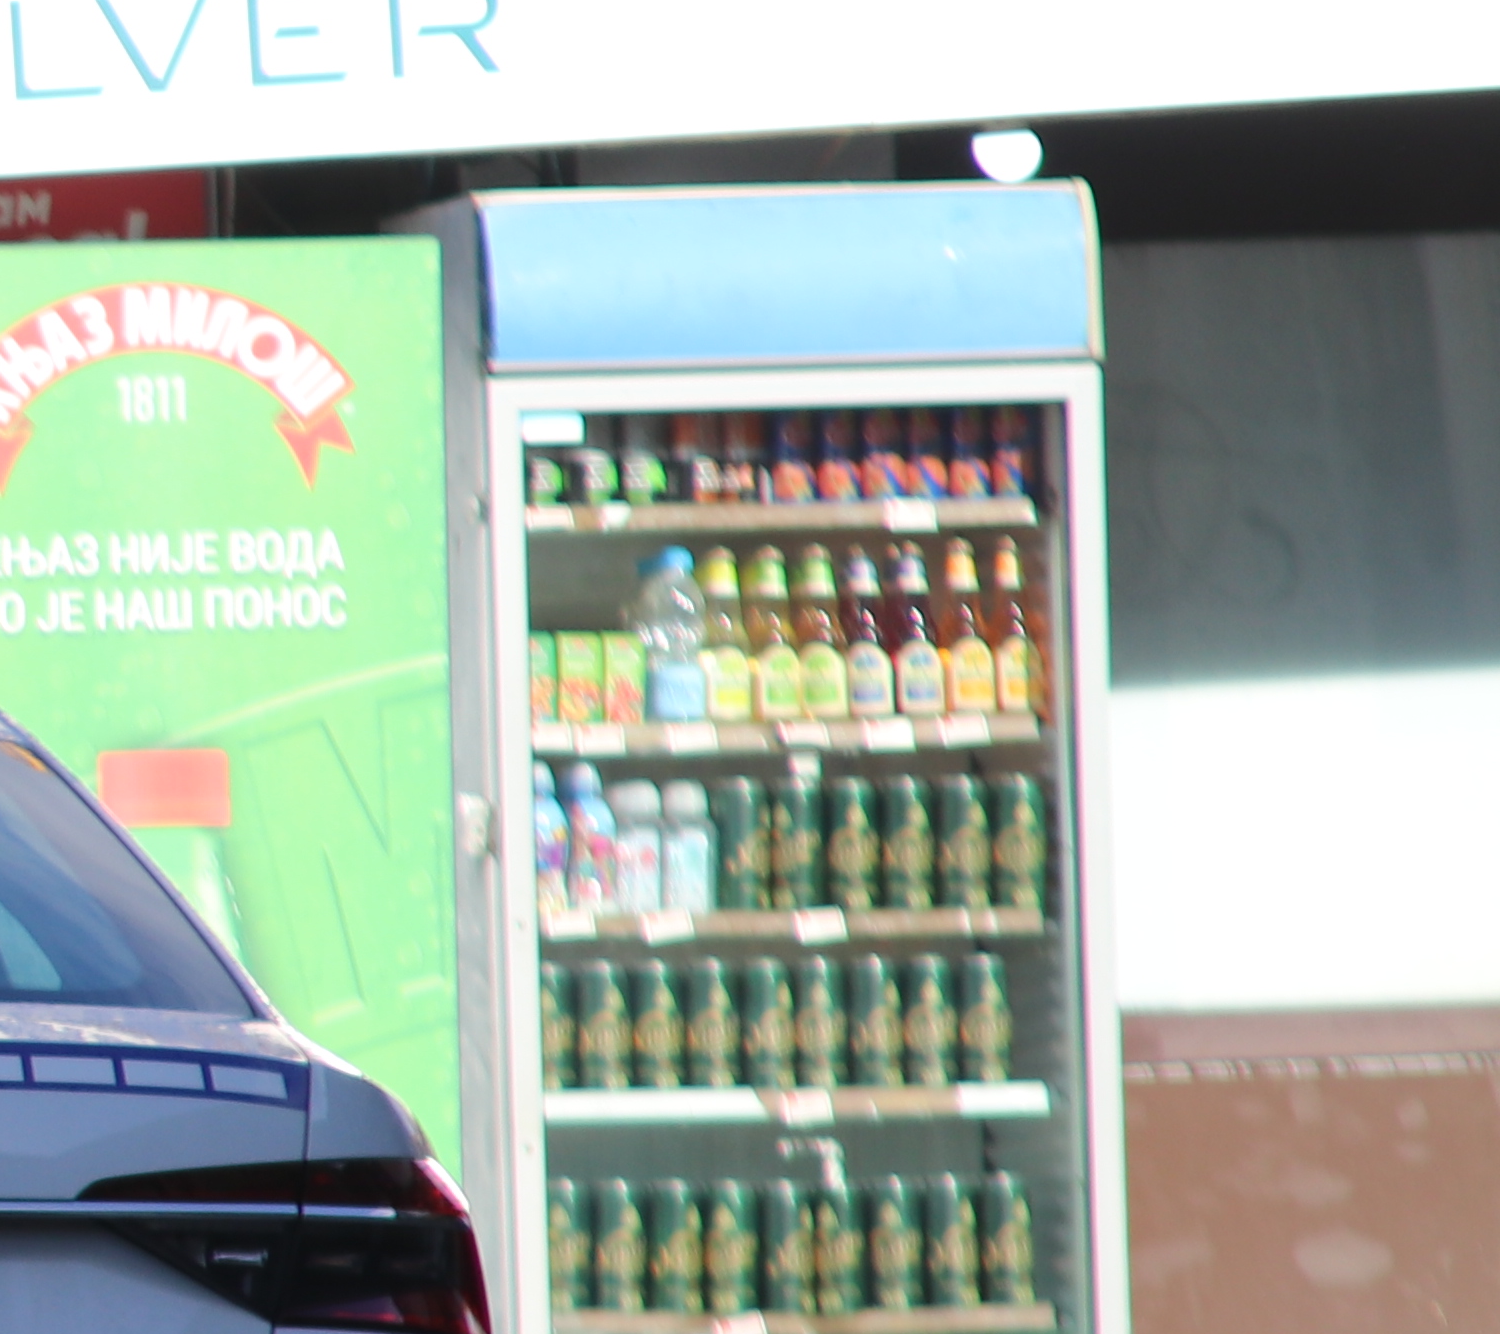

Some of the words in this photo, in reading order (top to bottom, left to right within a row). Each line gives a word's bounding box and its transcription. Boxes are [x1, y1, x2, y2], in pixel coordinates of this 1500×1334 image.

[122, 285, 346, 419] МИЛОШ
[115, 374, 189, 424] 1811
[109, 529, 221, 576] НИЈЕ
[227, 526, 346, 579] ВОДА
[34, 588, 86, 634] ЈЕ
[94, 586, 194, 631] НАШ
[202, 584, 349, 630] ПОНОС
